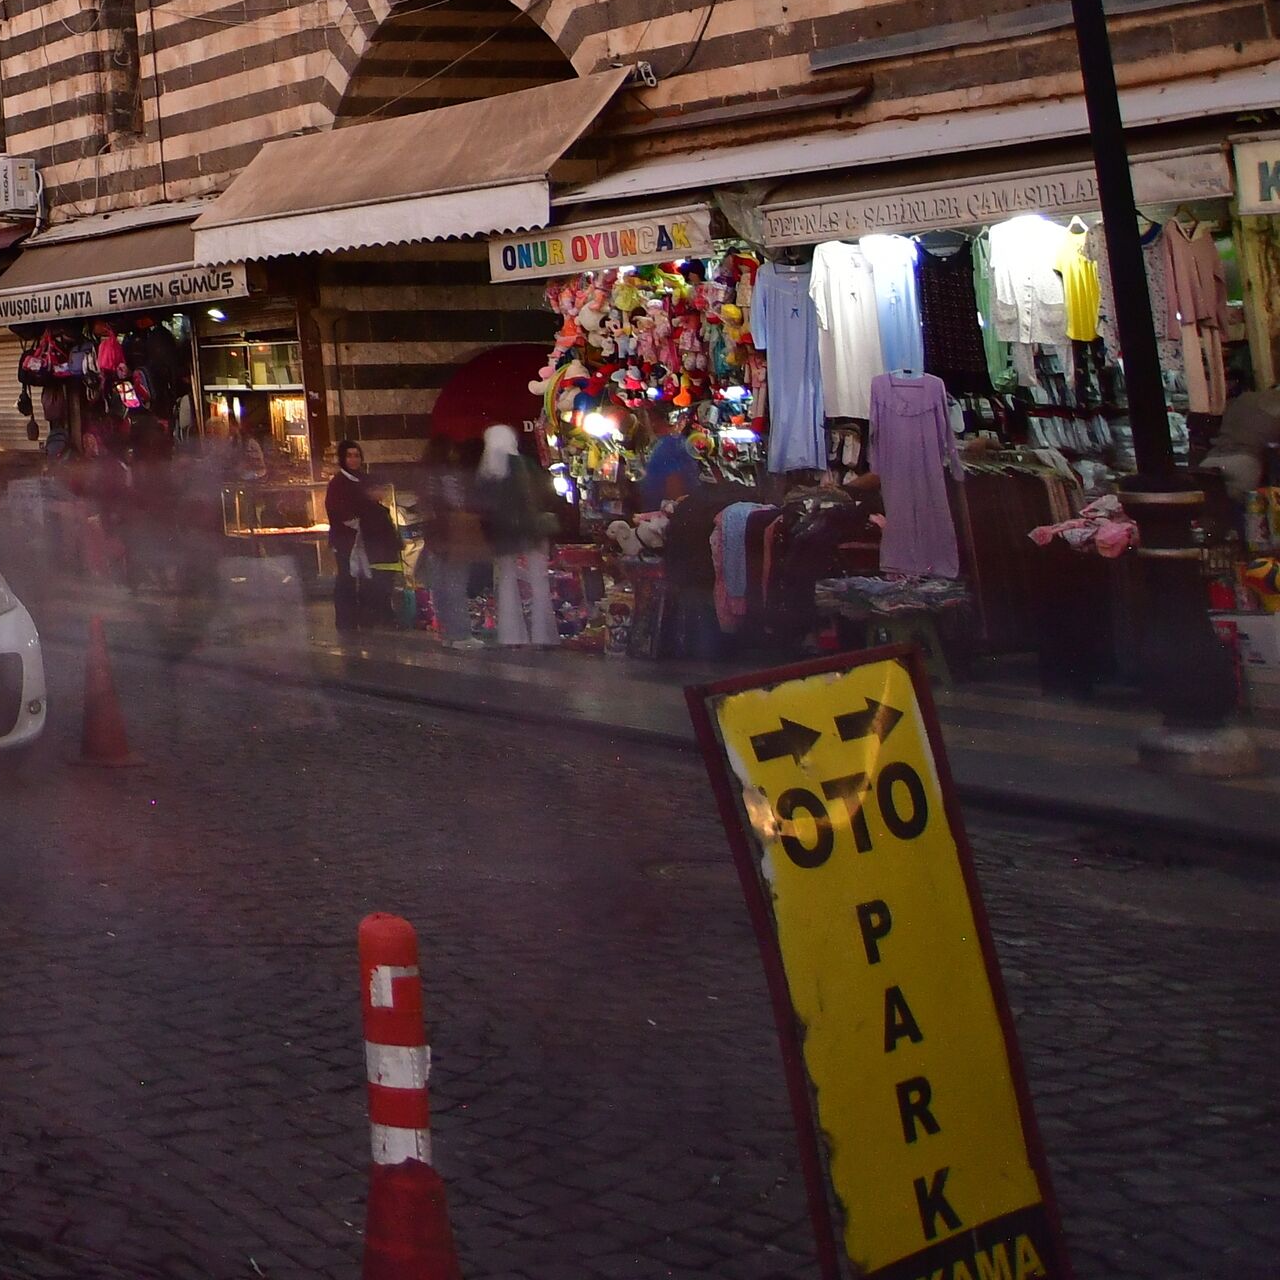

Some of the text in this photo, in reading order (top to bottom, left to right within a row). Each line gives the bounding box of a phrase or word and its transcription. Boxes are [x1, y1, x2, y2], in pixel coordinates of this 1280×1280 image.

[502, 222, 692, 271] ONUR OYUNCAK
[54, 290, 93, 315] ÇANTA
[108, 281, 164, 305] EYMEN
[168, 271, 235, 296] GÜMÜŞ
[776, 761, 928, 869] OTO
[855, 900, 962, 1241] PARK
[916, 1233, 1046, 1280] AMA
